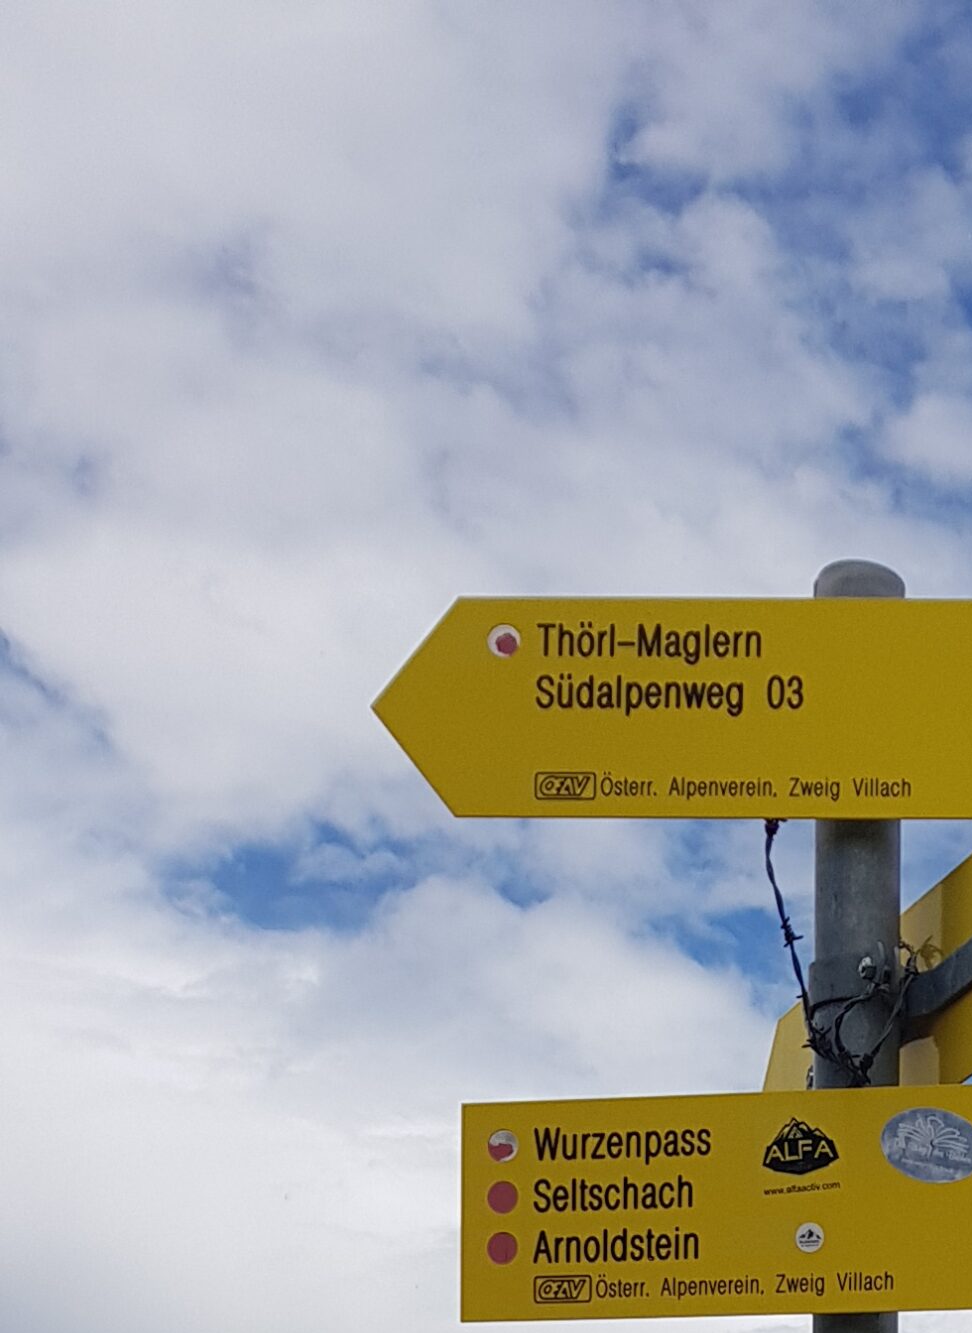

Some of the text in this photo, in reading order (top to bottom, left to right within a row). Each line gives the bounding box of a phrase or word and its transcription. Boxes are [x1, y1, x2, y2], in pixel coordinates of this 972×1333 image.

[536, 674, 804, 716] Südalpenweg 03
[599, 773, 658, 798] Österr.
[789, 778, 841, 801] Zweig
[852, 777, 912, 799] Villach
[534, 1127, 712, 1165] Wurzenpass
[765, 1140, 834, 1165] ALFA
[533, 1174, 694, 1213] Seltschach
[533, 1227, 700, 1265] Arnoldstein
[596, 1273, 650, 1299] Österr.
[775, 1273, 825, 1298] Zweig
[837, 1271, 894, 1293] Villach
